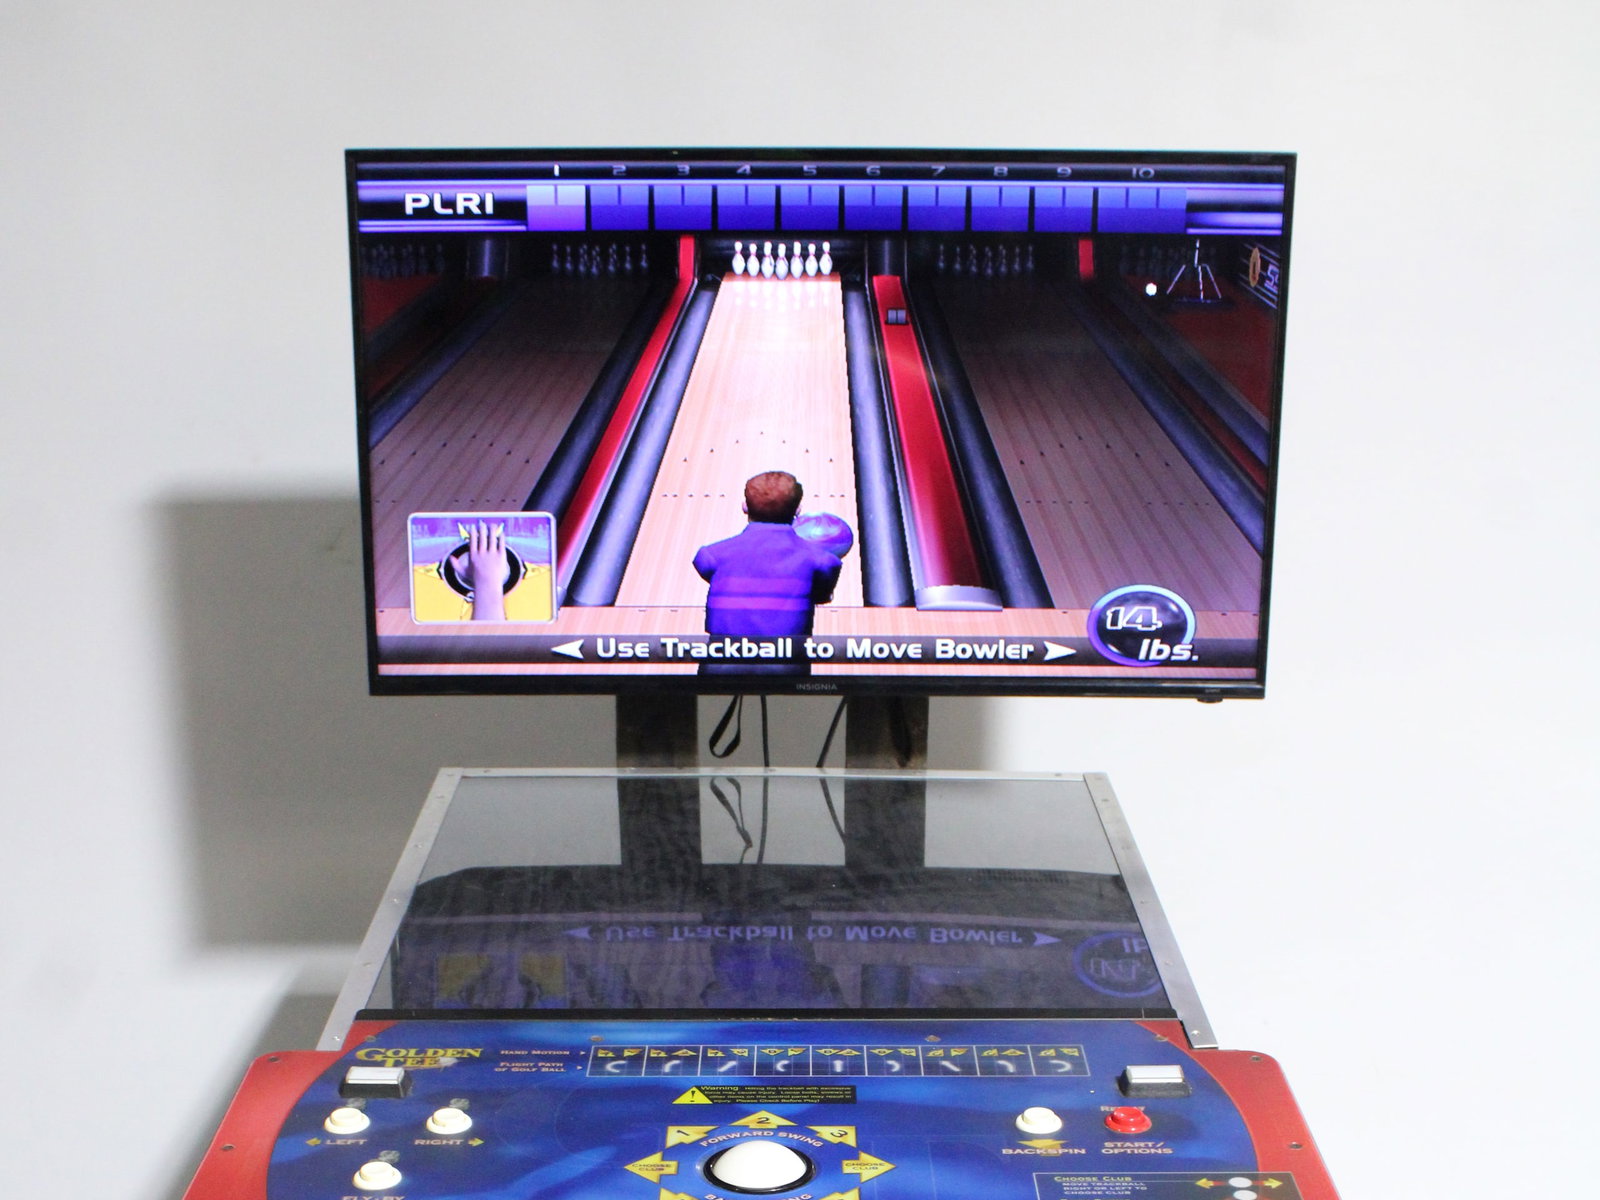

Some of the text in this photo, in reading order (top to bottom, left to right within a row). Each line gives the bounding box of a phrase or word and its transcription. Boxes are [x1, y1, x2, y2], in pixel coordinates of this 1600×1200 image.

[553, 163, 1155, 179] 1 2 3 4 5 6 7 8 9 10
[1106, 606, 1162, 631] 14
[596, 637, 1035, 660] Use Trackball to Move Bowler
[1138, 638, 1199, 661] lbs.
[355, 1048, 484, 1061] GOLDEN
[756, 1116, 772, 1124] 2
[699, 1131, 824, 1148] FORWARD SWING
[829, 1129, 849, 1138] 3
